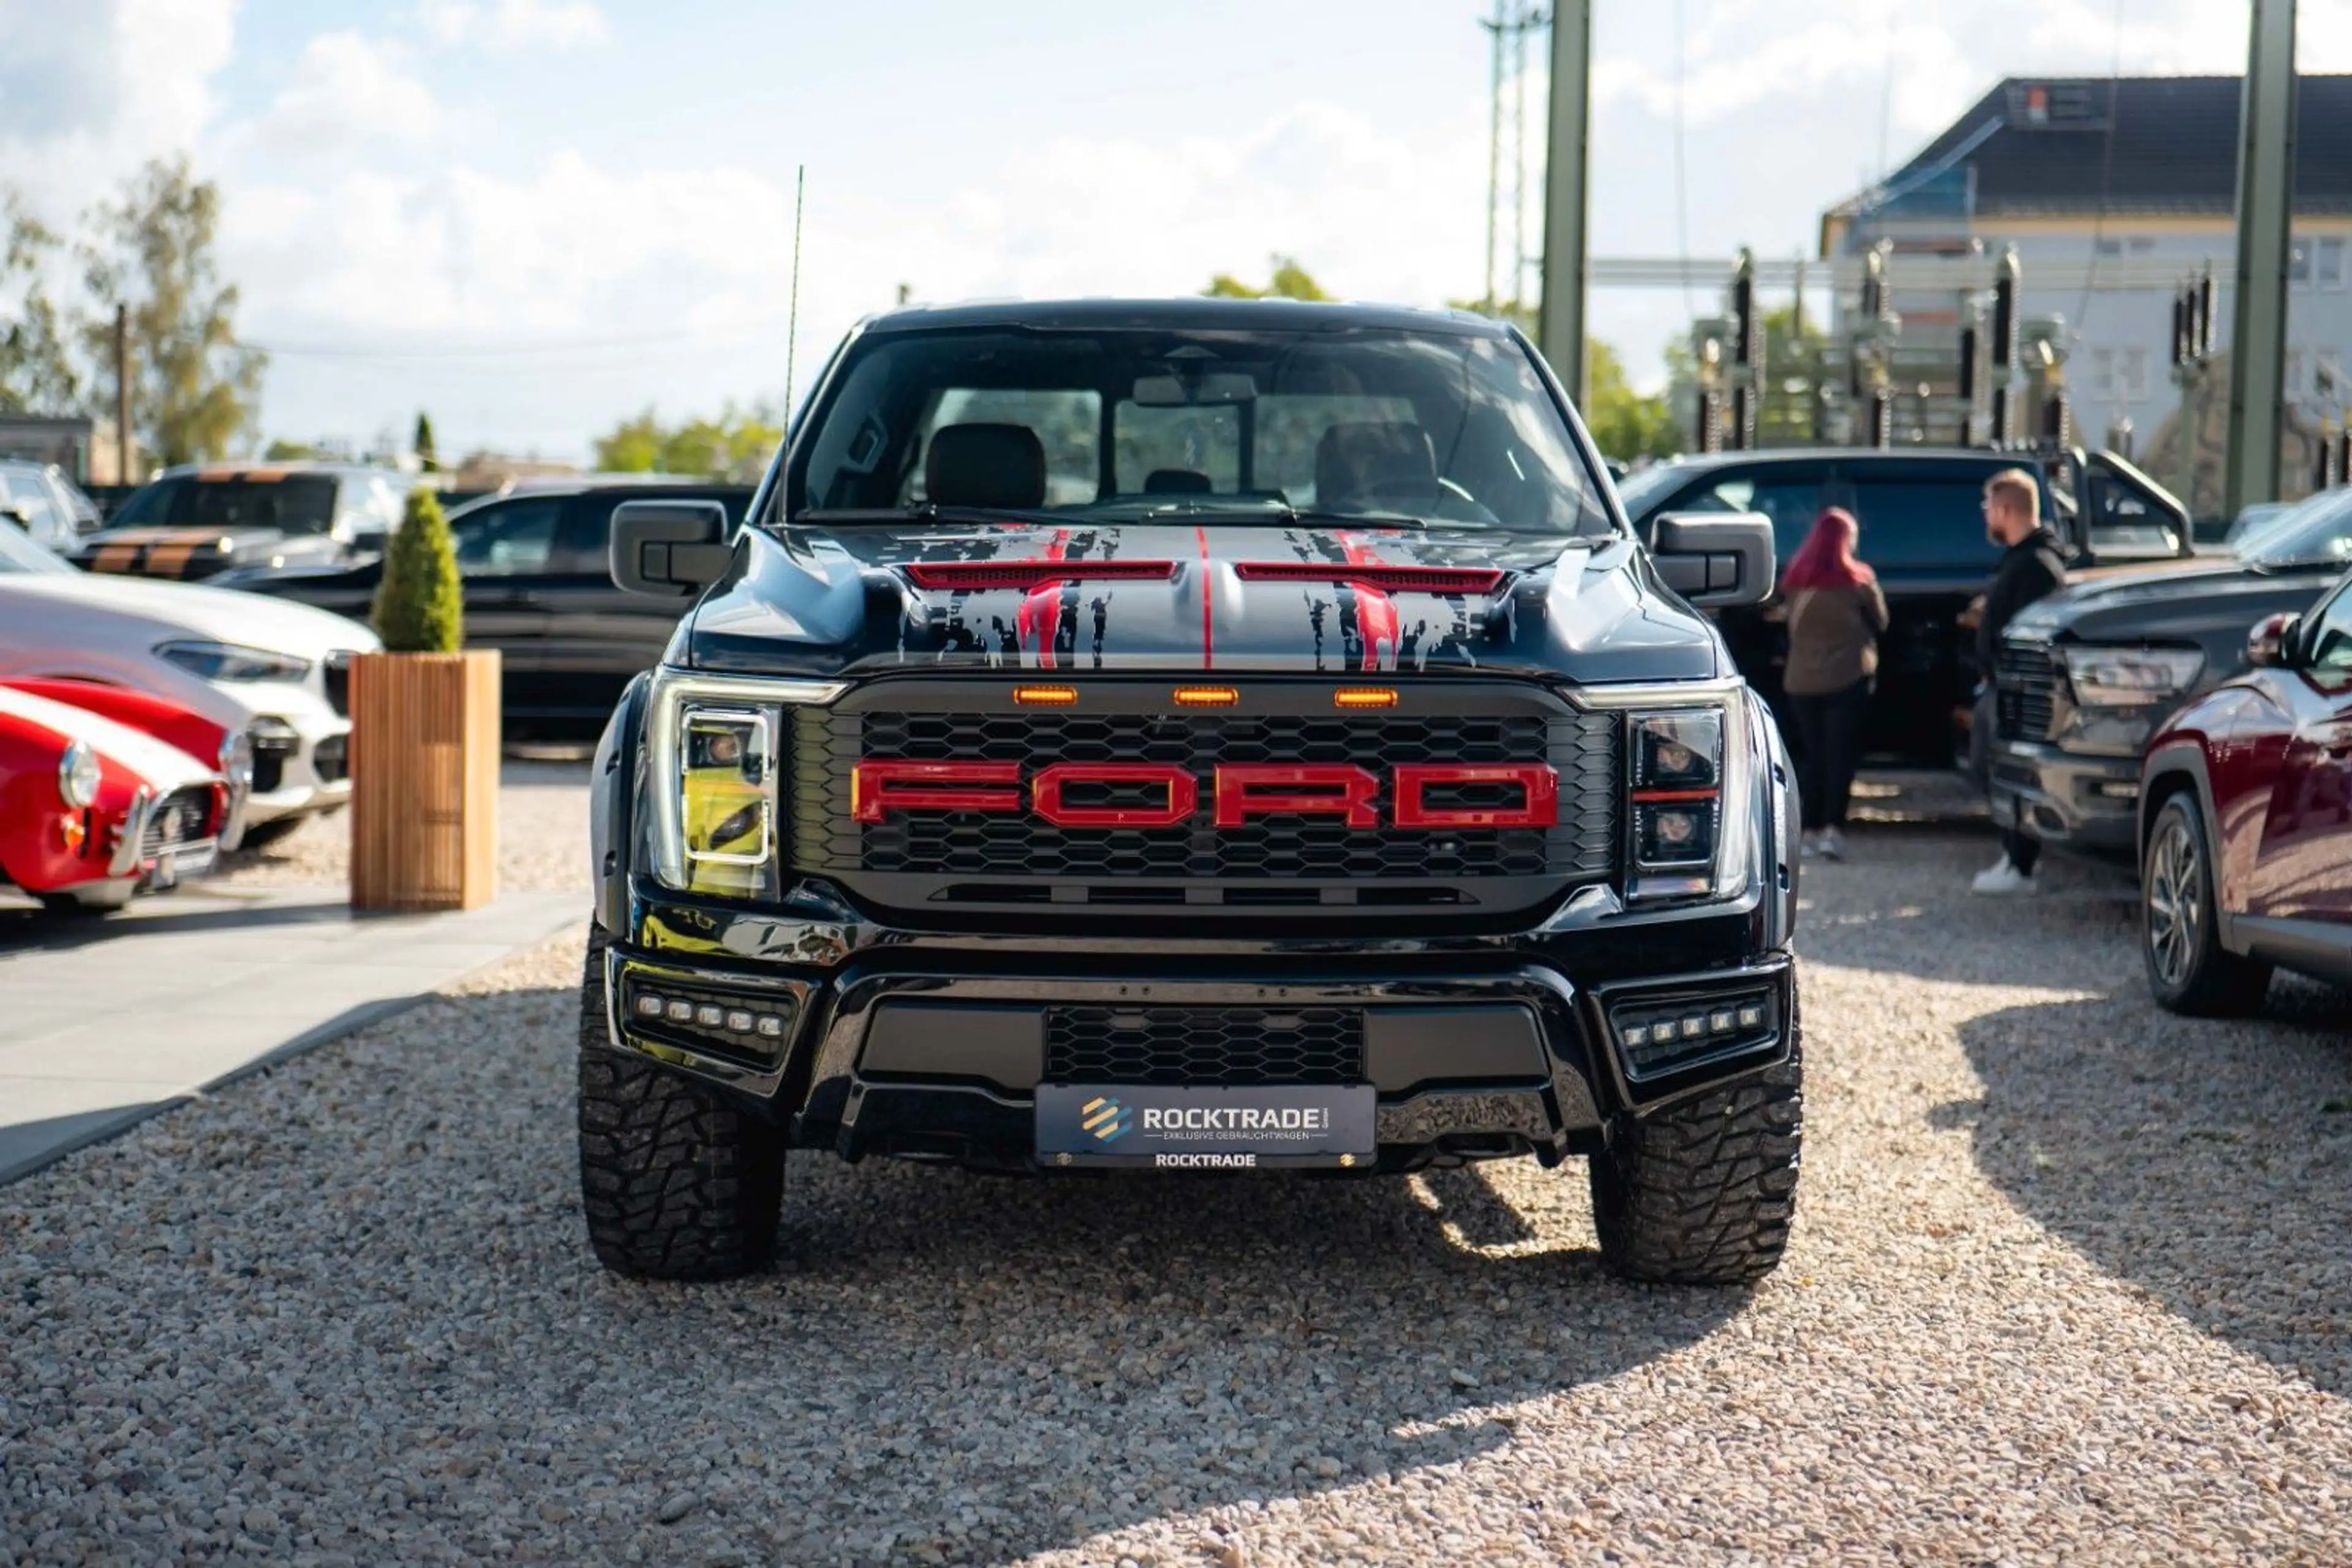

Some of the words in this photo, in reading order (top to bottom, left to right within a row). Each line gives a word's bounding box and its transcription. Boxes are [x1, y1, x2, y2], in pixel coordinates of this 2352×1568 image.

[851, 760, 1558, 831] FORD
[1143, 1108, 1319, 1128] ROCKTRADE
[1164, 1131, 1214, 1140] EXKLUSIVE
[1216, 1131, 1310, 1140] GEBRAUCHTWAGEN
[1156, 1154, 1256, 1167] ROCKTRADE
